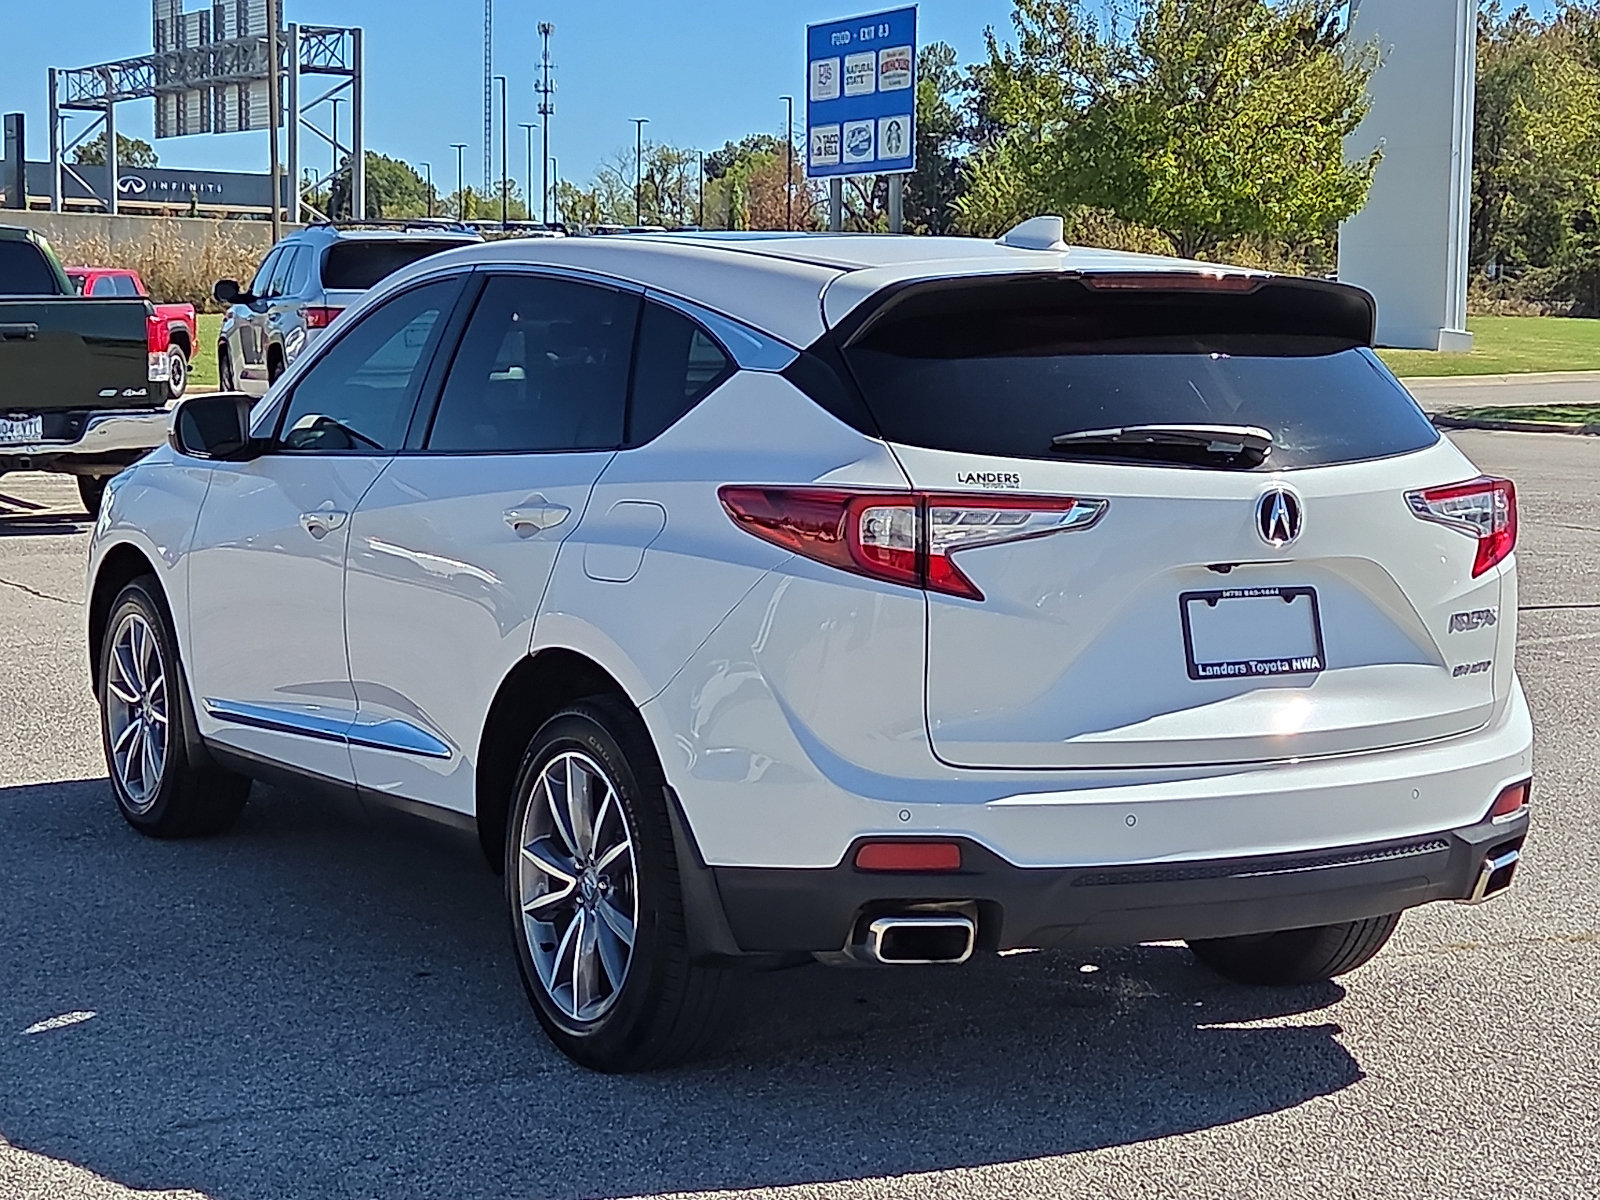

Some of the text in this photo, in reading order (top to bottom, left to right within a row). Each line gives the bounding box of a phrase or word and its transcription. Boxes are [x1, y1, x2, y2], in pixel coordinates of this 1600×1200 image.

[831, 31, 851, 45] FOOD
[860, 26, 875, 41] EXIT
[846, 62, 874, 75] NATURAL
[152, 181, 222, 193] INFINITI
[0, 422, 14, 435] 04
[957, 472, 1020, 484] LANDERS
[1198, 656, 1321, 676] Landers Toyota NWA
